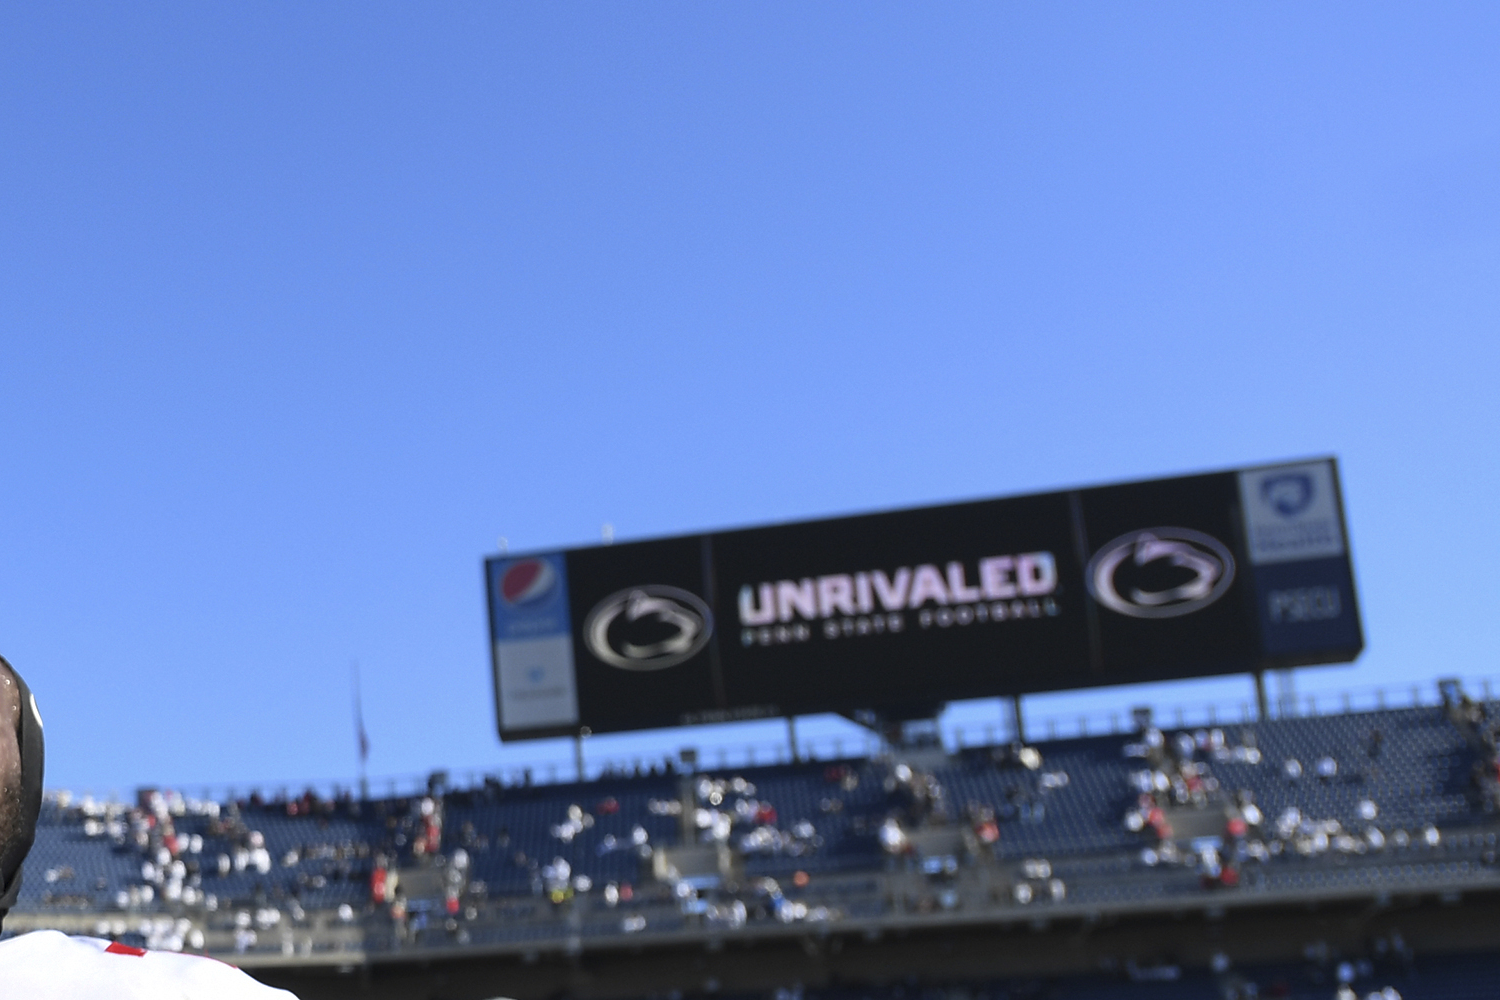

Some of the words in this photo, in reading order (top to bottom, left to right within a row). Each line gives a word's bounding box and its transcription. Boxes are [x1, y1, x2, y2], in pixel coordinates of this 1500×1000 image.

[738, 550, 1058, 627] UNRIVALED
[741, 623, 811, 647] PENN
[823, 611, 904, 640] STATE
[918, 597, 1060, 629] FOOTBALL
